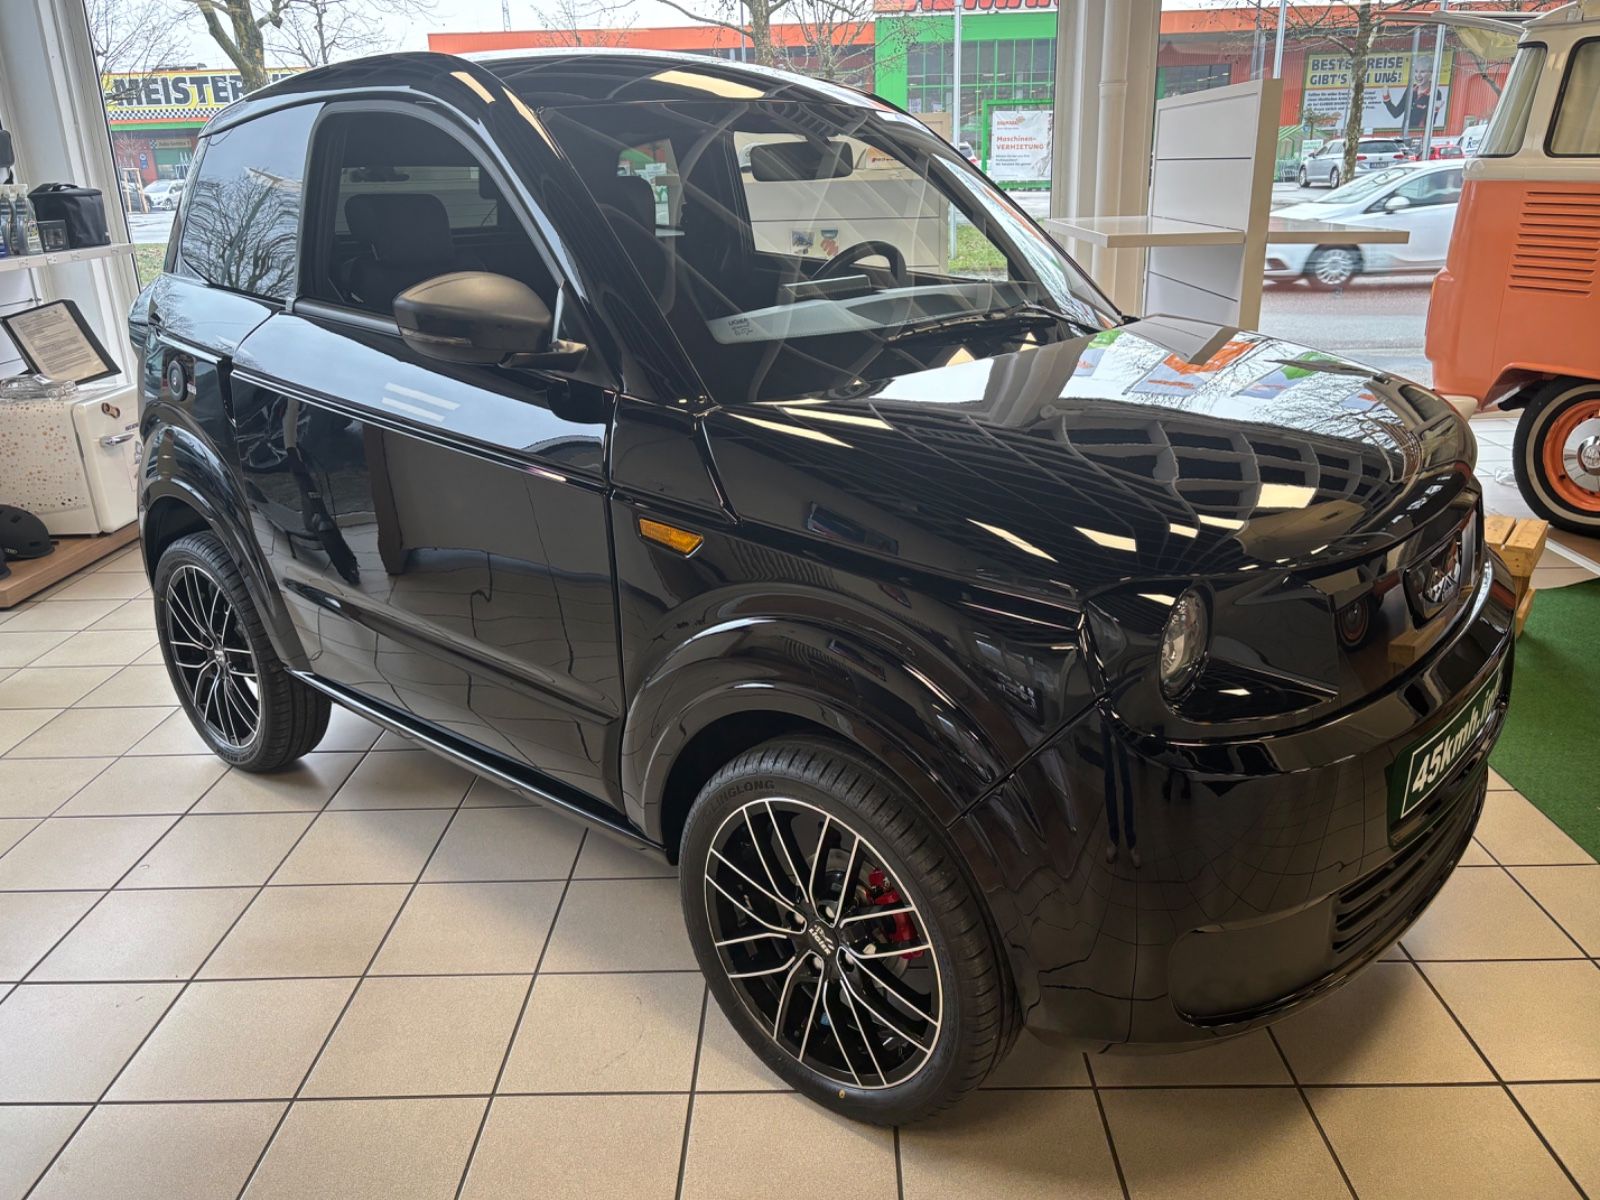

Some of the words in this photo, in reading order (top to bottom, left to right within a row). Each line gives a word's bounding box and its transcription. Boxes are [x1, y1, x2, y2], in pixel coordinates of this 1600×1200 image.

[1366, 57, 1403, 69] REISE
[1310, 74, 1347, 85] GIBT'S
[1374, 72, 1402, 83] UNS!
